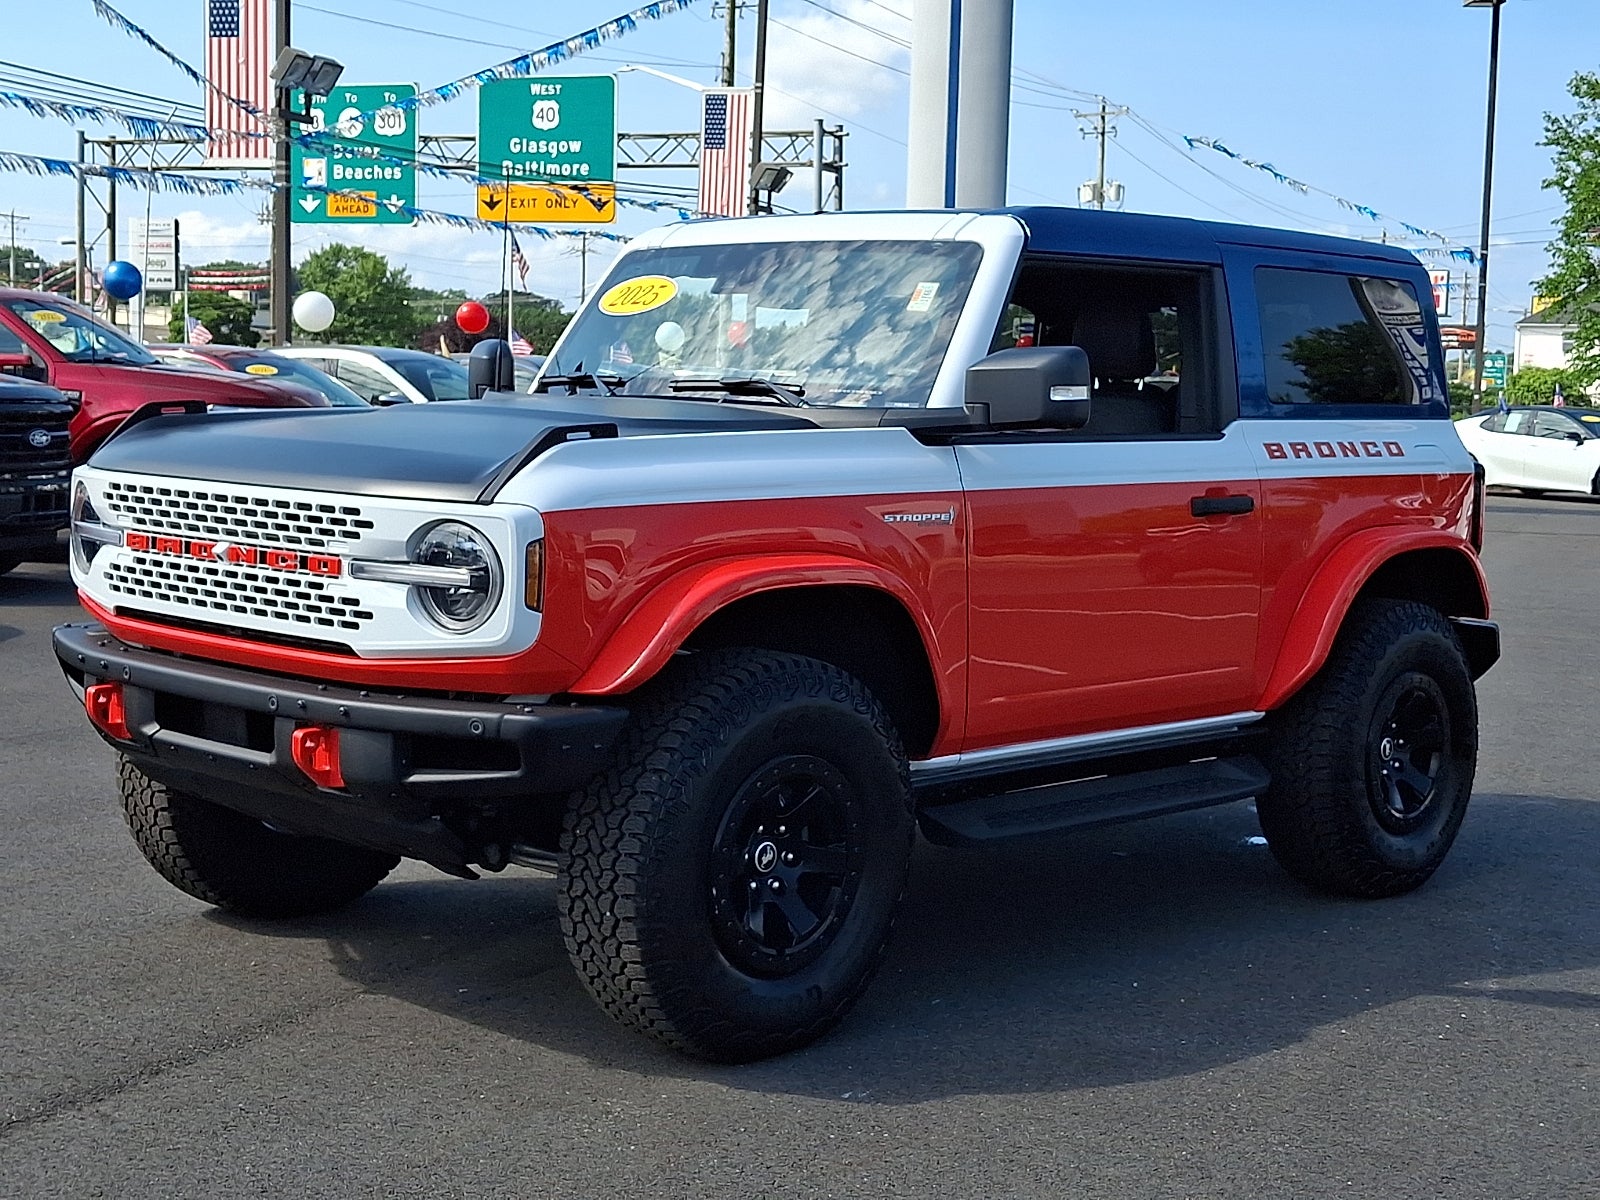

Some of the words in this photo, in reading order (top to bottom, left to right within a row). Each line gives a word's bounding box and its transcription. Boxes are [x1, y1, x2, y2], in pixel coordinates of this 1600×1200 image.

[530, 83, 562, 95] WEST
[344, 92, 358, 103] To
[383, 92, 397, 103] To
[536, 107, 556, 123] 40
[509, 138, 582, 158] Glasgow
[333, 164, 402, 180] Beaches
[502, 160, 590, 176] Baltimore
[334, 204, 369, 213] AHEAD
[510, 198, 538, 208] EXIT
[545, 198, 579, 209] ONLY
[608, 284, 668, 307] 2025
[1263, 441, 1405, 460] BRONCO
[883, 513, 950, 522] STROPPE
[126, 532, 342, 576] BRONCO
